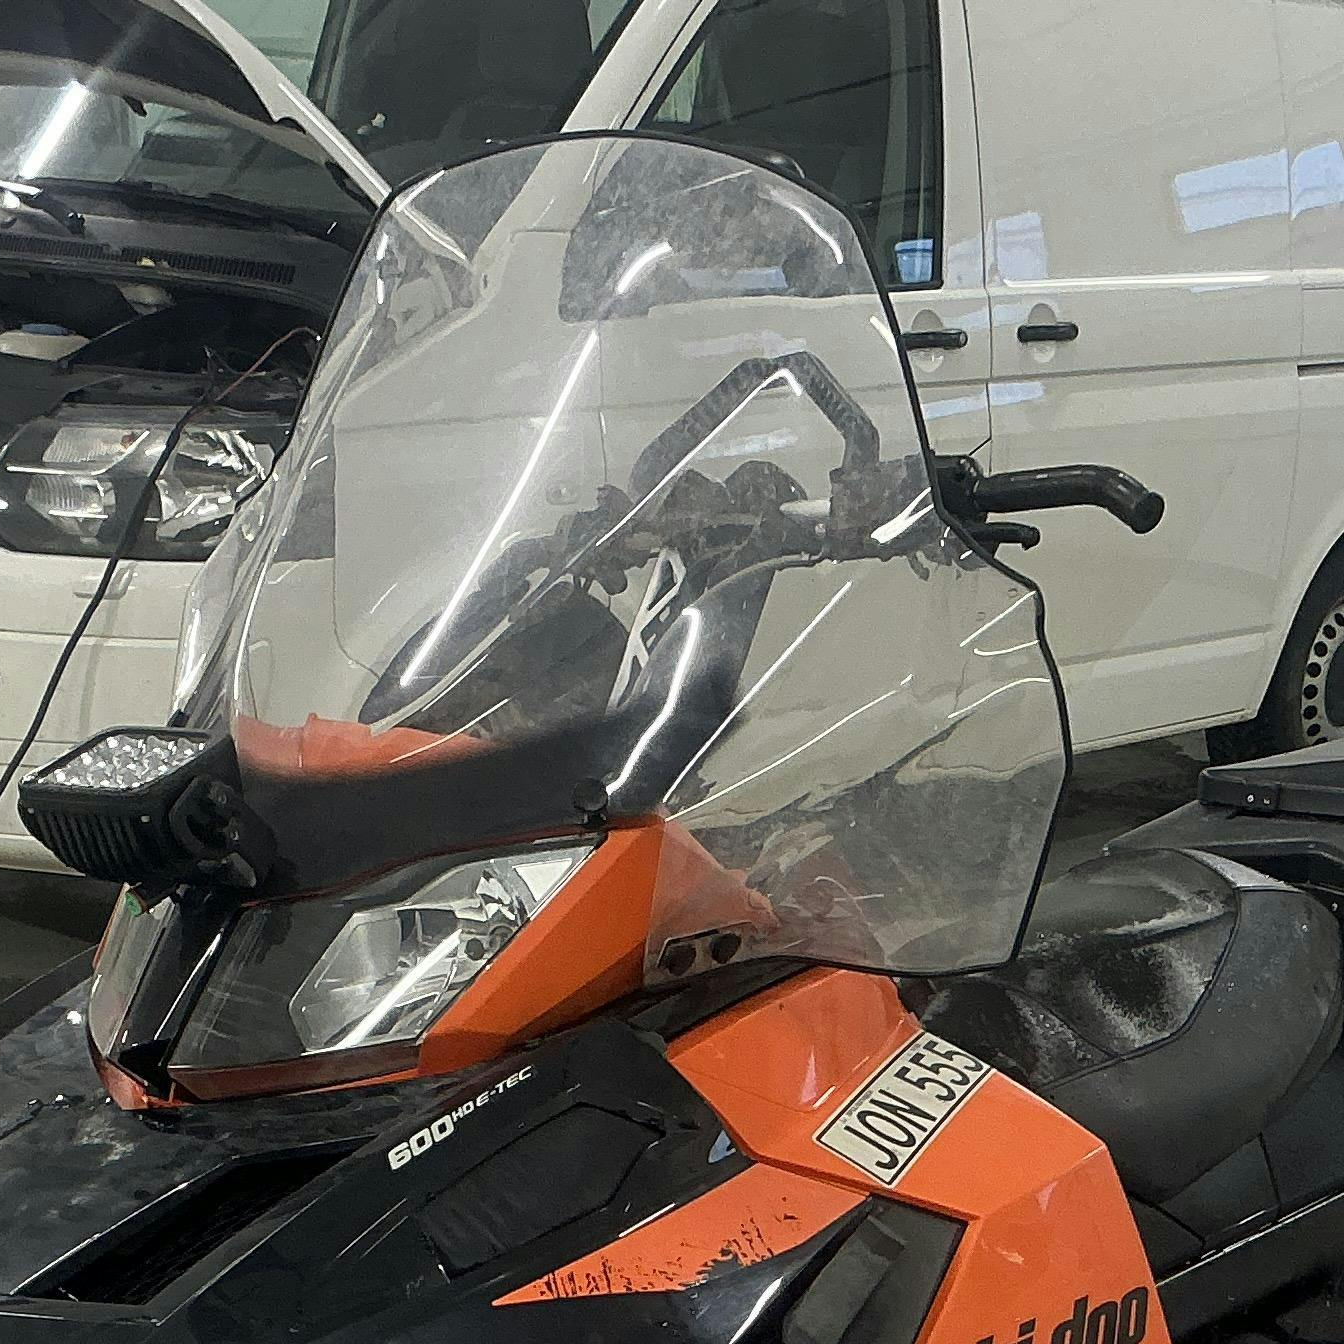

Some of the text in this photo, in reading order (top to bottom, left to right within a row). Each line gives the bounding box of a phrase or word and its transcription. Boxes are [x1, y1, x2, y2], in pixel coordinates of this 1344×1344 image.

[387, 1114, 455, 1171] 600
[475, 1064, 533, 1107] E-TEC
[843, 1039, 984, 1170] JON 555
